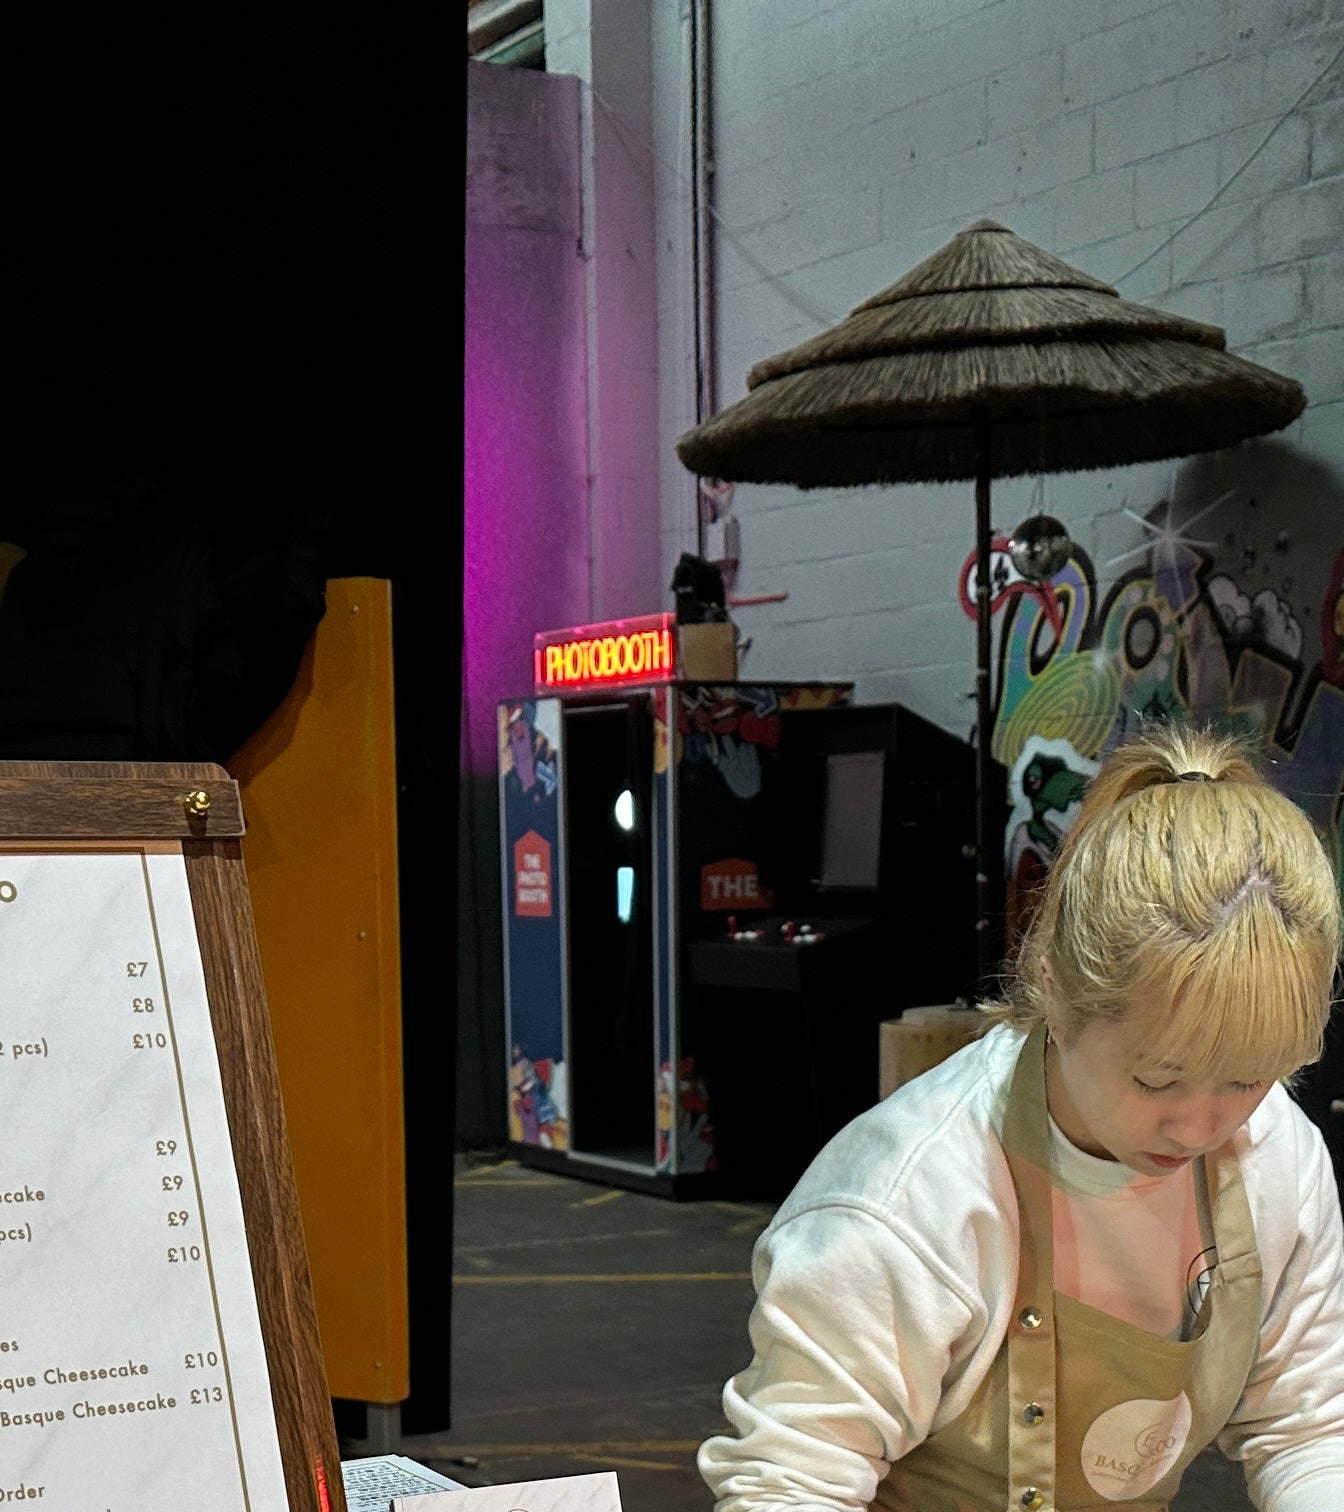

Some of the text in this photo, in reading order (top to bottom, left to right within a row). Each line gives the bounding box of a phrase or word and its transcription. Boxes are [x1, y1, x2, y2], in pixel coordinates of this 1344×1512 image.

[545, 629, 671, 686] PHOTOBOOTH
[709, 874, 759, 898] THE
[126, 961, 148, 978] £7
[132, 997, 154, 1013] £8
[12, 1037, 48, 1060] pcs)
[132, 1032, 167, 1049] £10
[155, 1139, 177, 1156] £9
[162, 1175, 183, 1191] £9
[167, 1210, 189, 1227] £9
[167, 1245, 200, 1263] £10
[184, 1351, 218, 1369] £10
[43, 1359, 149, 1385] Cheesecake
[190, 1386, 223, 1405] £13
[0, 1410, 65, 1428] Basque
[72, 1392, 176, 1419] Cheesecake
